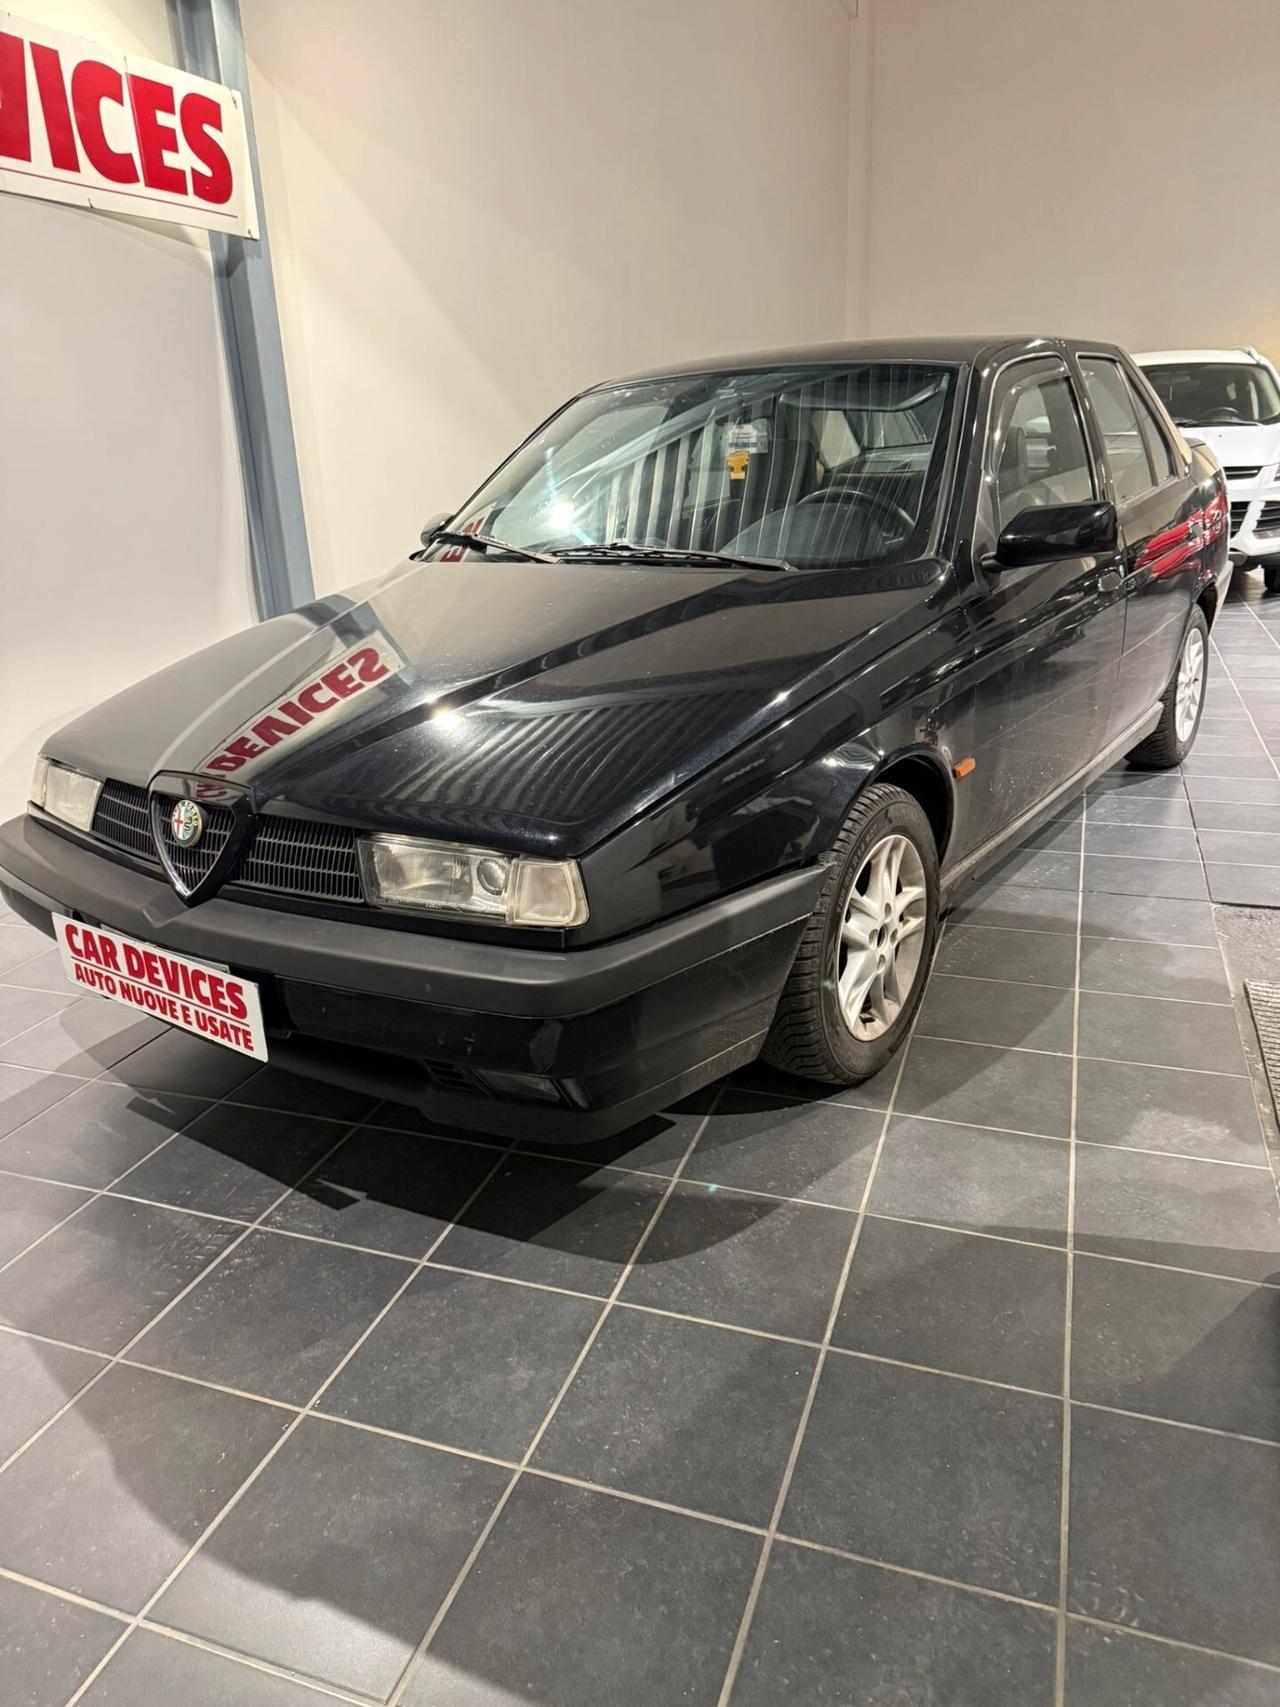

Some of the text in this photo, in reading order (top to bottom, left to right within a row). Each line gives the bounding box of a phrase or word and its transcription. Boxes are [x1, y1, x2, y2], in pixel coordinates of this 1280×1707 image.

[65, 924, 248, 1020] CAR DEVICES
[75, 964, 255, 1052] AUTO NUOVE E USATE
